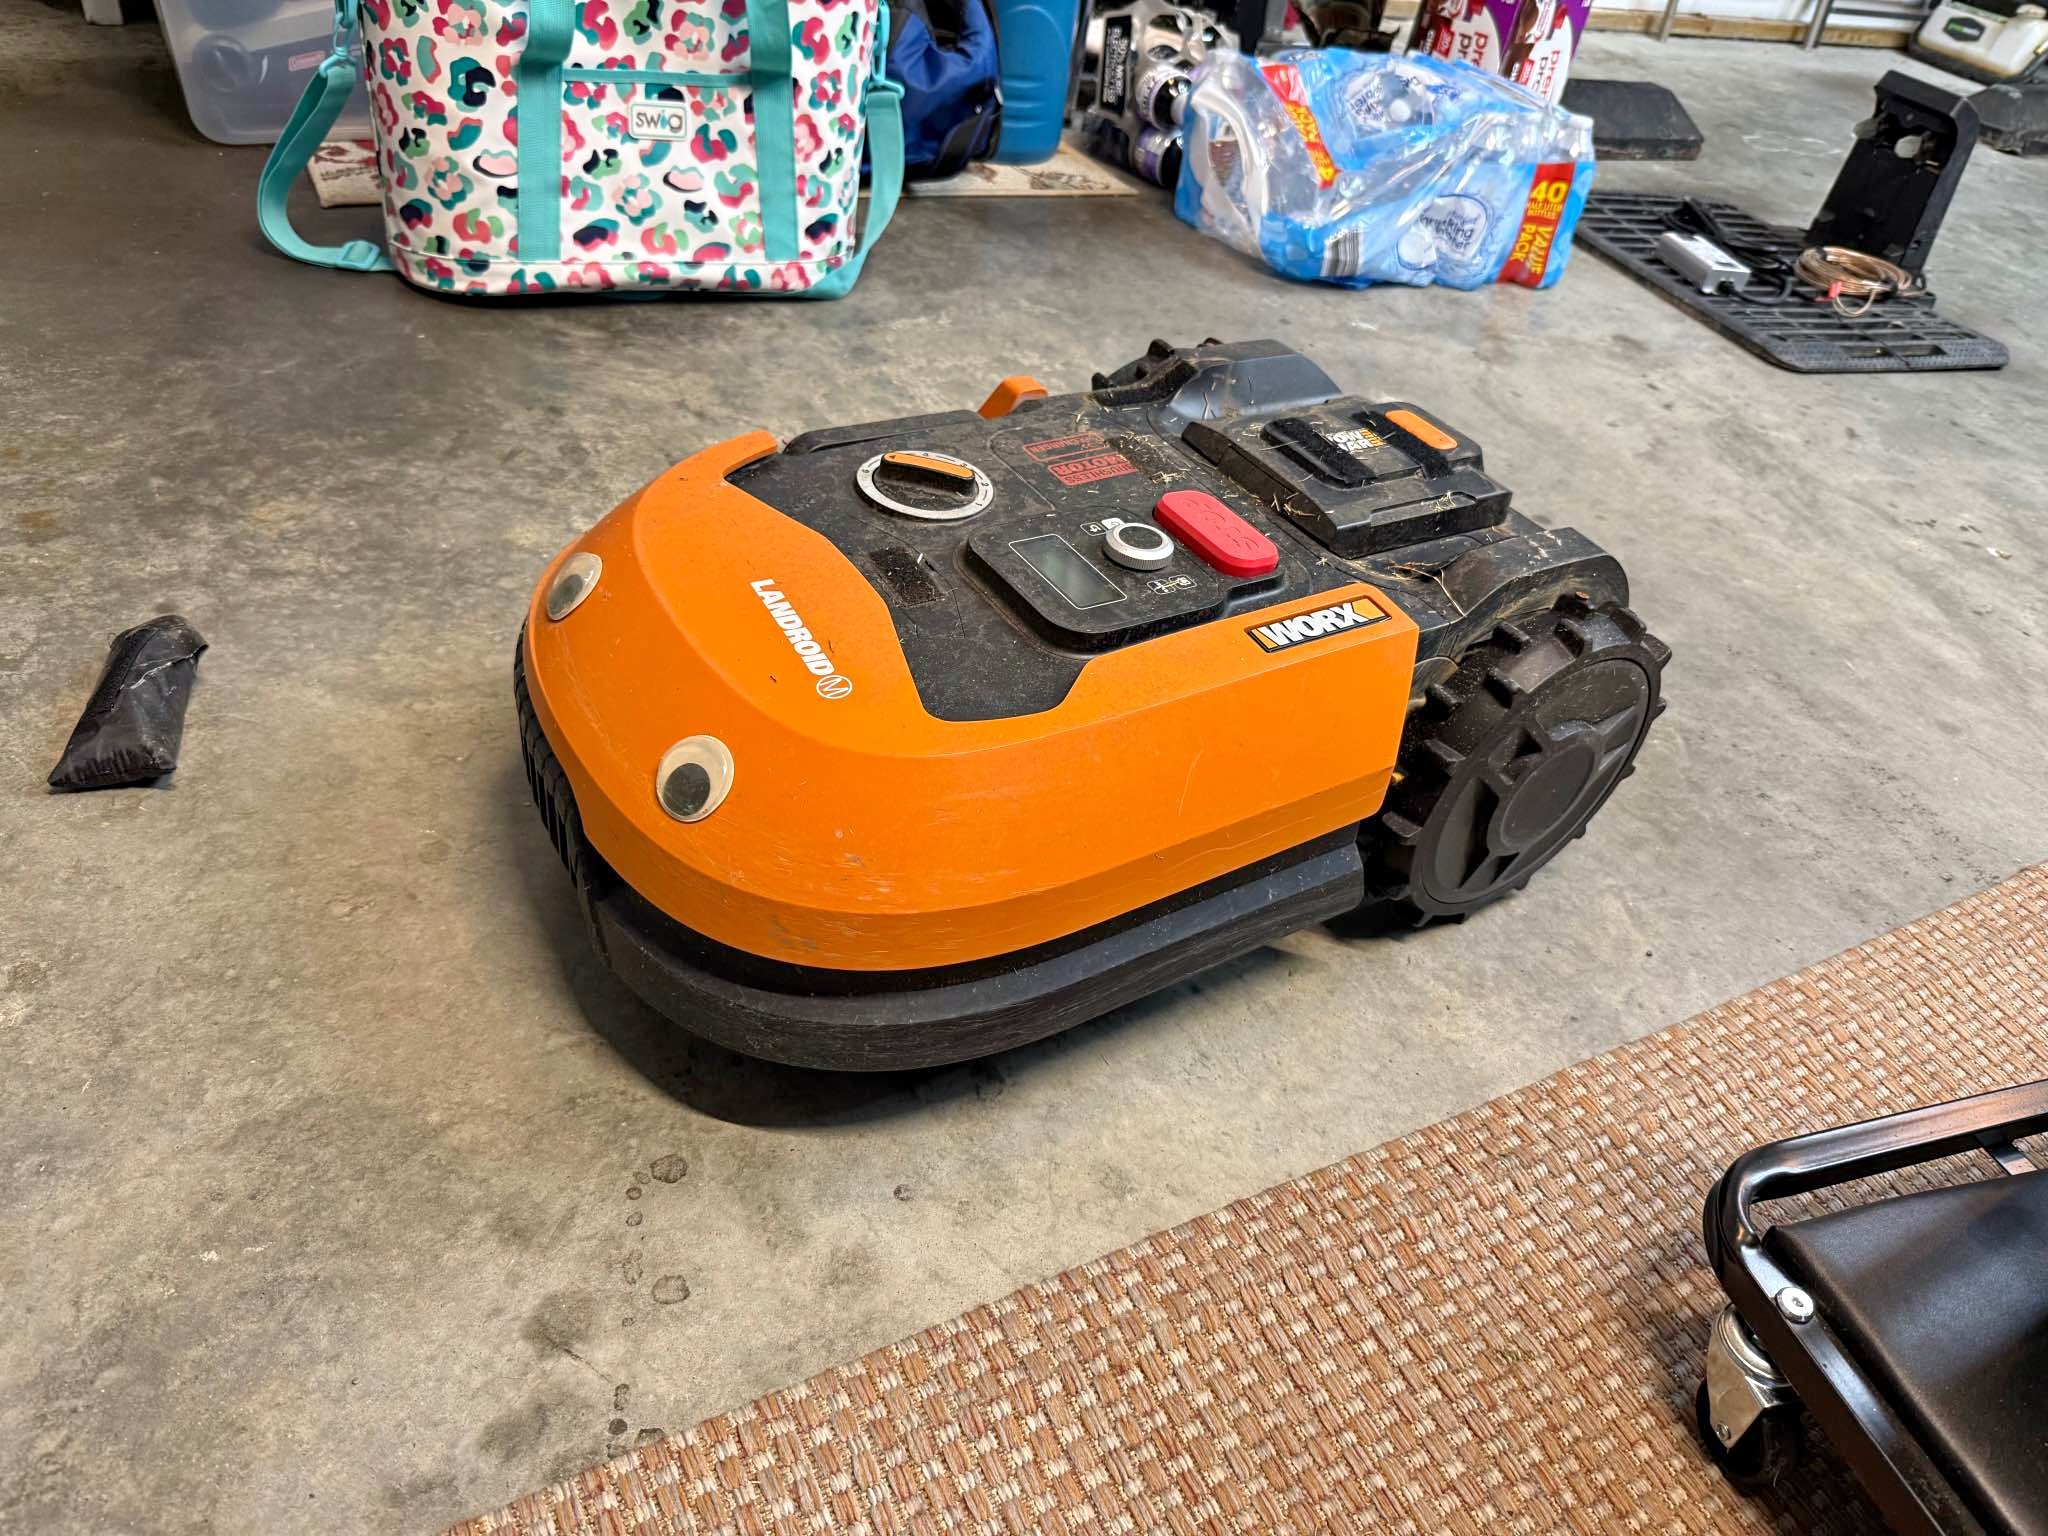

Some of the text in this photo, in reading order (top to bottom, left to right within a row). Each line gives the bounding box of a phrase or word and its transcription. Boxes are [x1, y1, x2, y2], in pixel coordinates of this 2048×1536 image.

[1530, 181, 1569, 204] 40
[1511, 223, 1537, 263] PACK
[749, 578, 836, 676] LANDROID
[1257, 602, 1370, 647] WORX
